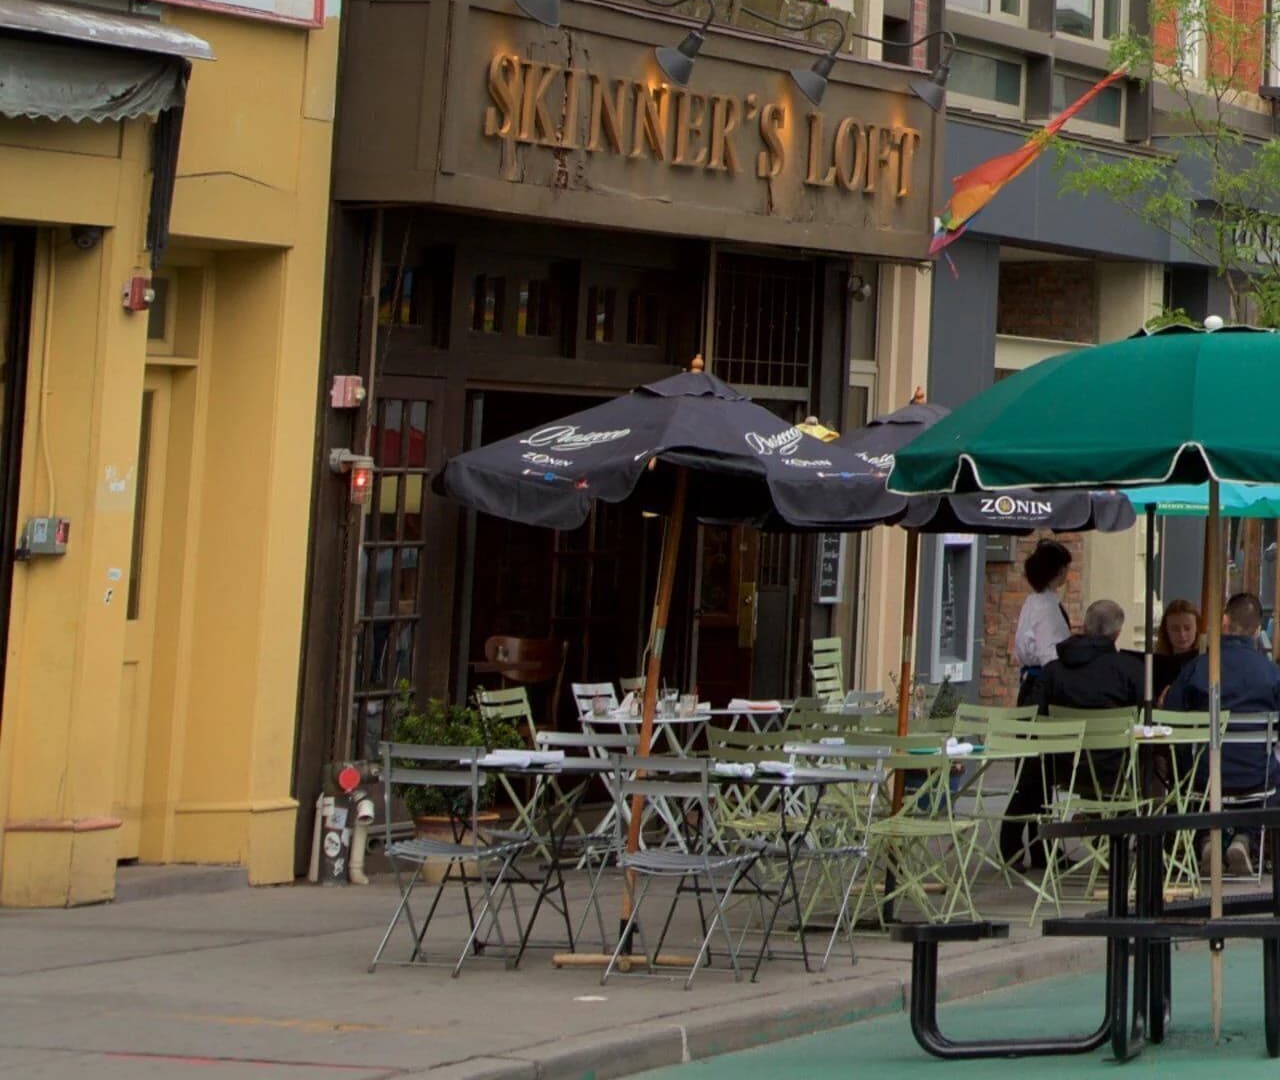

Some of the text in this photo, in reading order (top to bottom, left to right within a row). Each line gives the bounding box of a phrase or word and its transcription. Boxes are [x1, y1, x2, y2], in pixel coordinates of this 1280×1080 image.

[485, 52, 922, 200] SKINNER'S LOFT
[981, 496, 1052, 515] ZONIN
